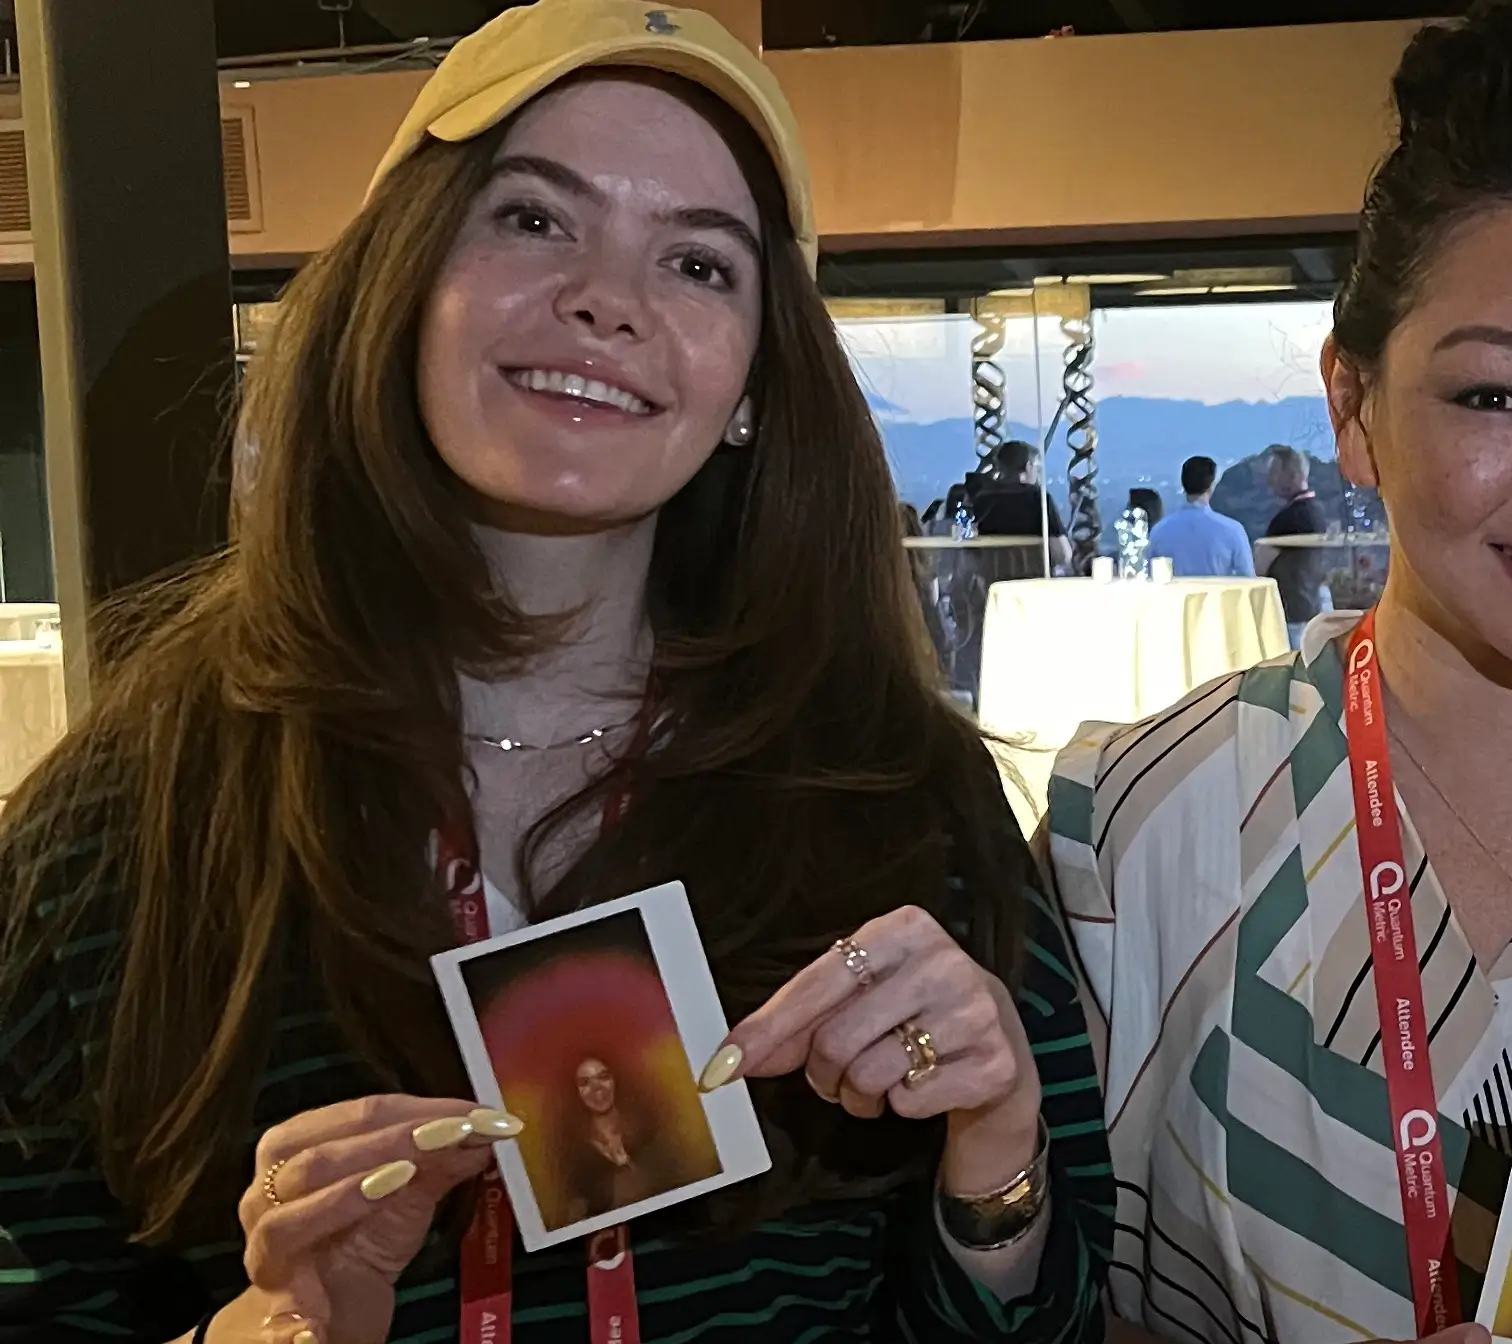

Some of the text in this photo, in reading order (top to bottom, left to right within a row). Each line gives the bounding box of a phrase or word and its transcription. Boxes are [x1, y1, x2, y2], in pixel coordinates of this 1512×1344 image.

[1348, 674, 1360, 713] Metric
[1360, 669, 1374, 726] Quantum
[1364, 759, 1384, 828] Attendee
[1371, 901, 1386, 944] Metric
[1387, 898, 1405, 962] Quantum
[1396, 998, 1414, 1071] Attendee
[1404, 1153, 1418, 1198] Metric
[1418, 1151, 1437, 1219] Quantum
